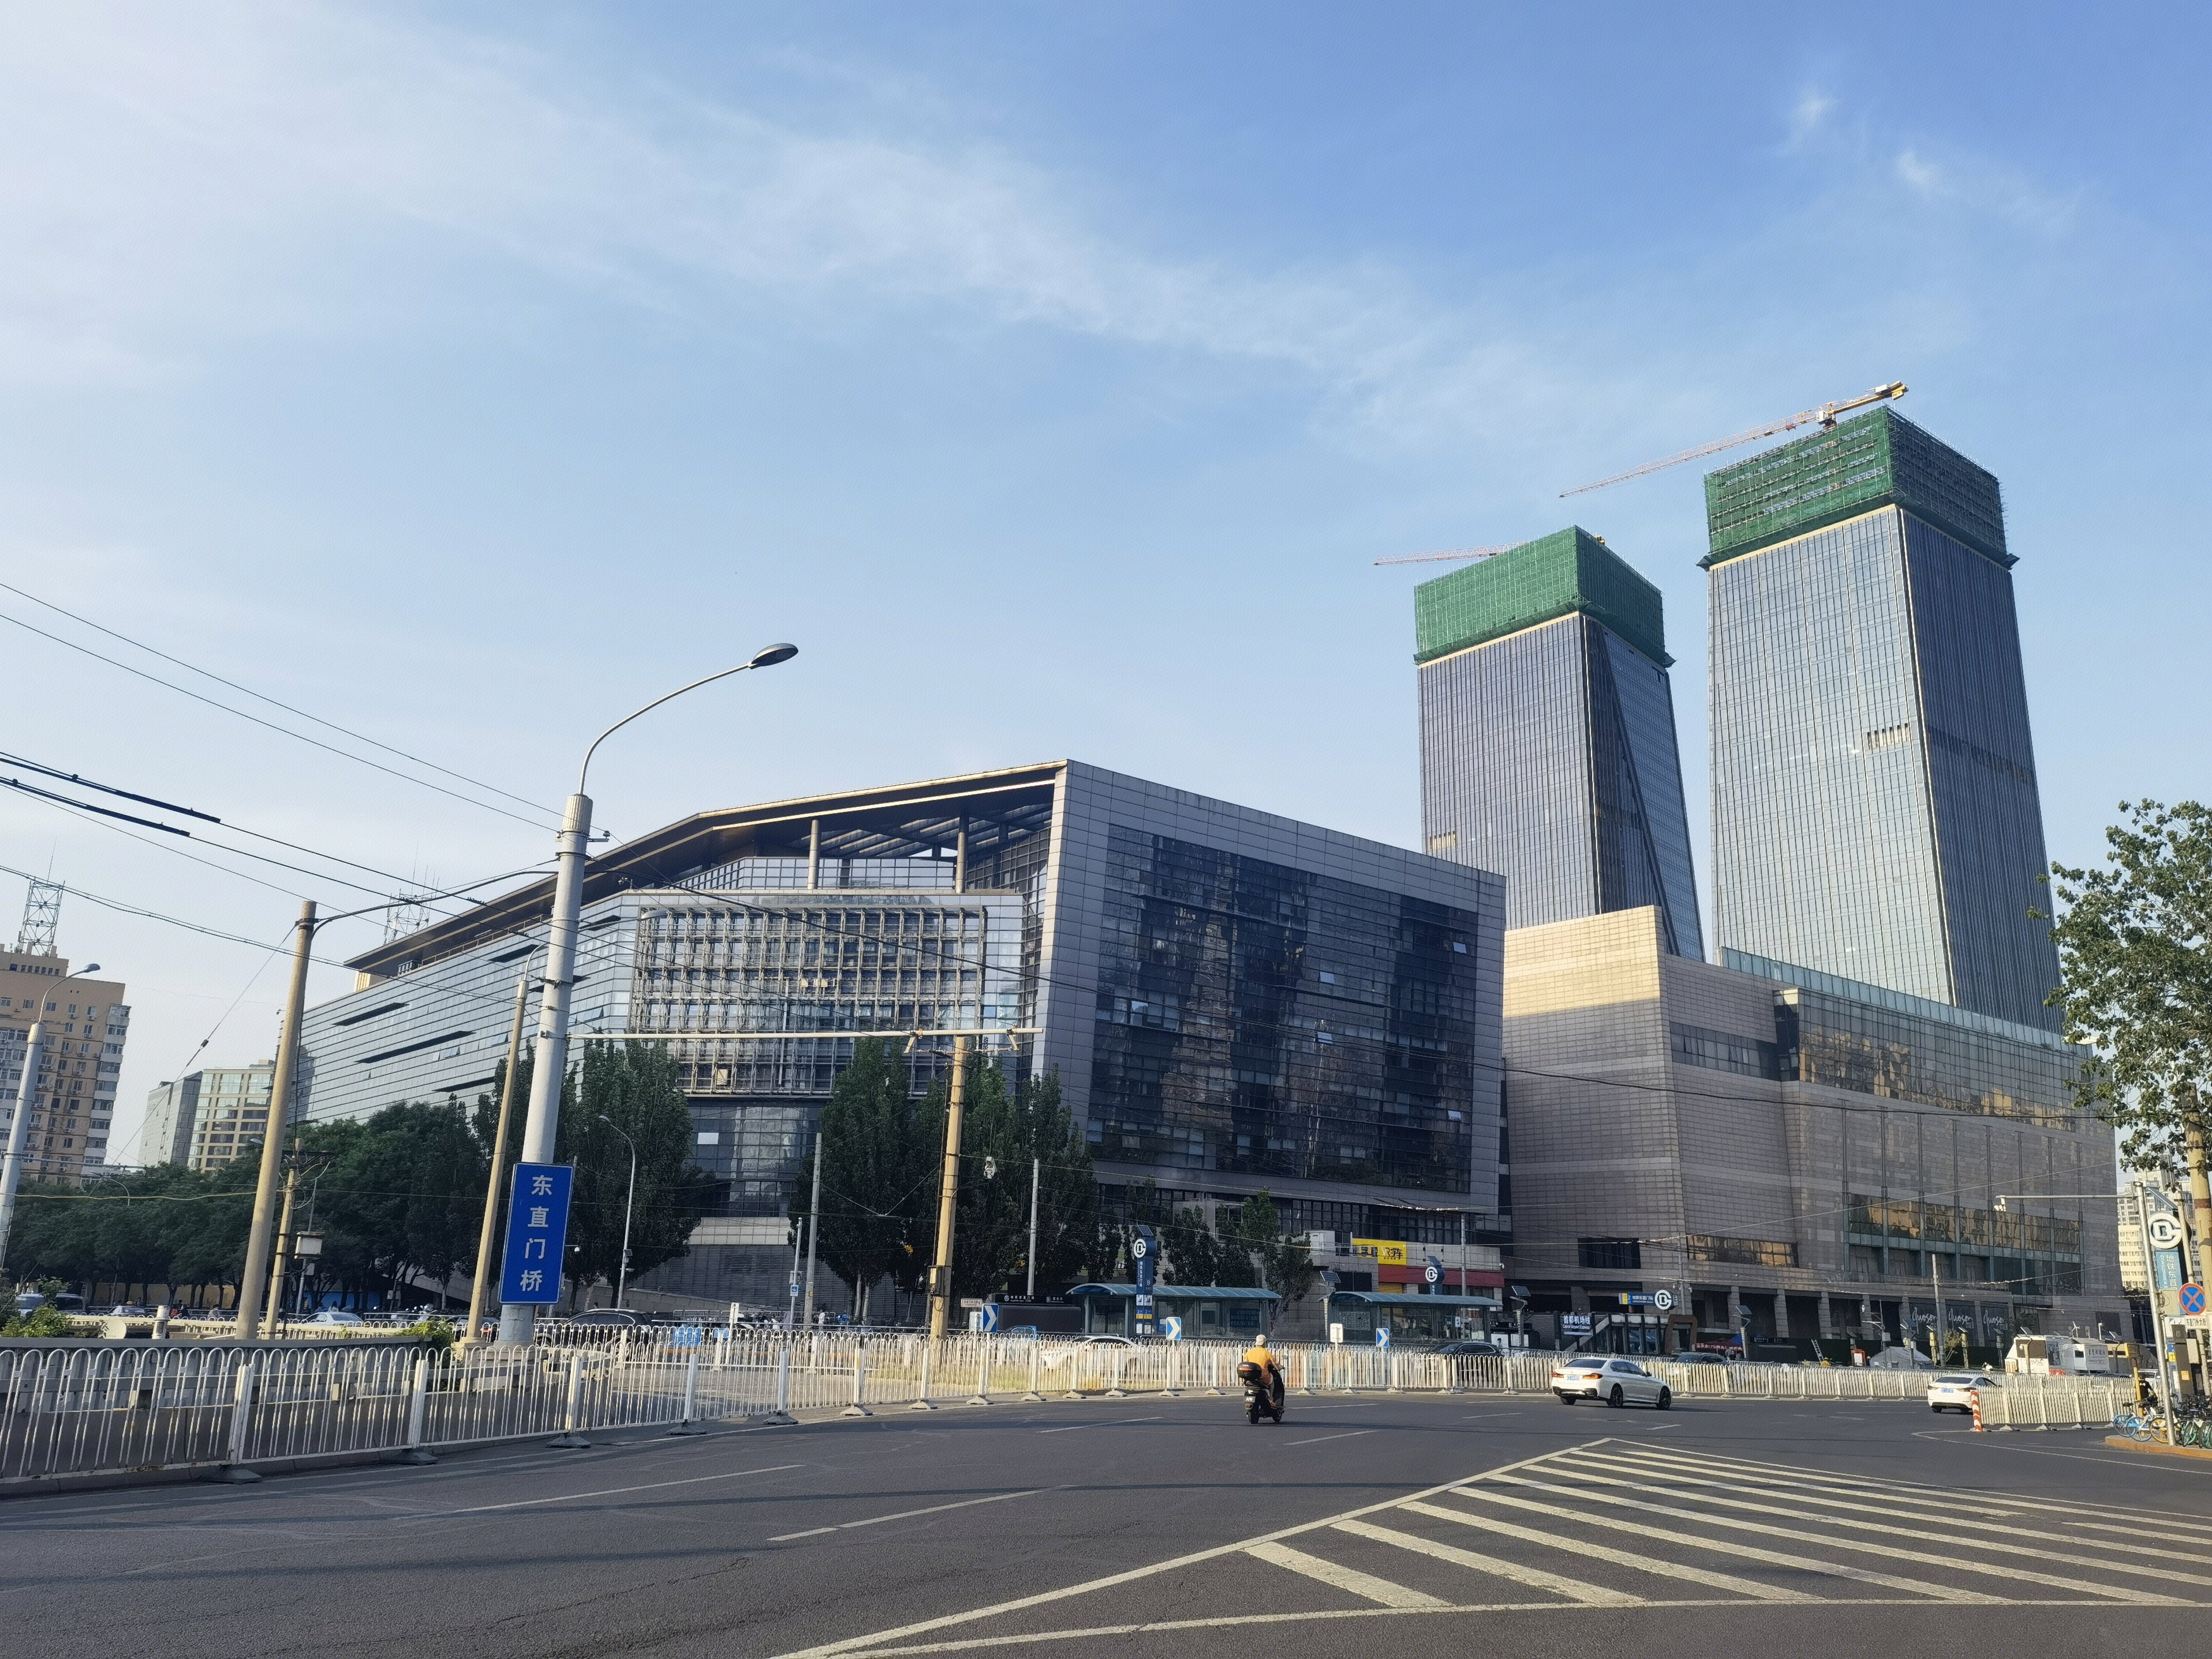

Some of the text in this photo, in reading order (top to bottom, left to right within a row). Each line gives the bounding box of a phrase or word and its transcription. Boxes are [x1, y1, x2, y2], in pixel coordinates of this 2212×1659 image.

[520, 1175, 553, 1291] 东直门桥
[1563, 1315, 1590, 1325] 首都机场线
